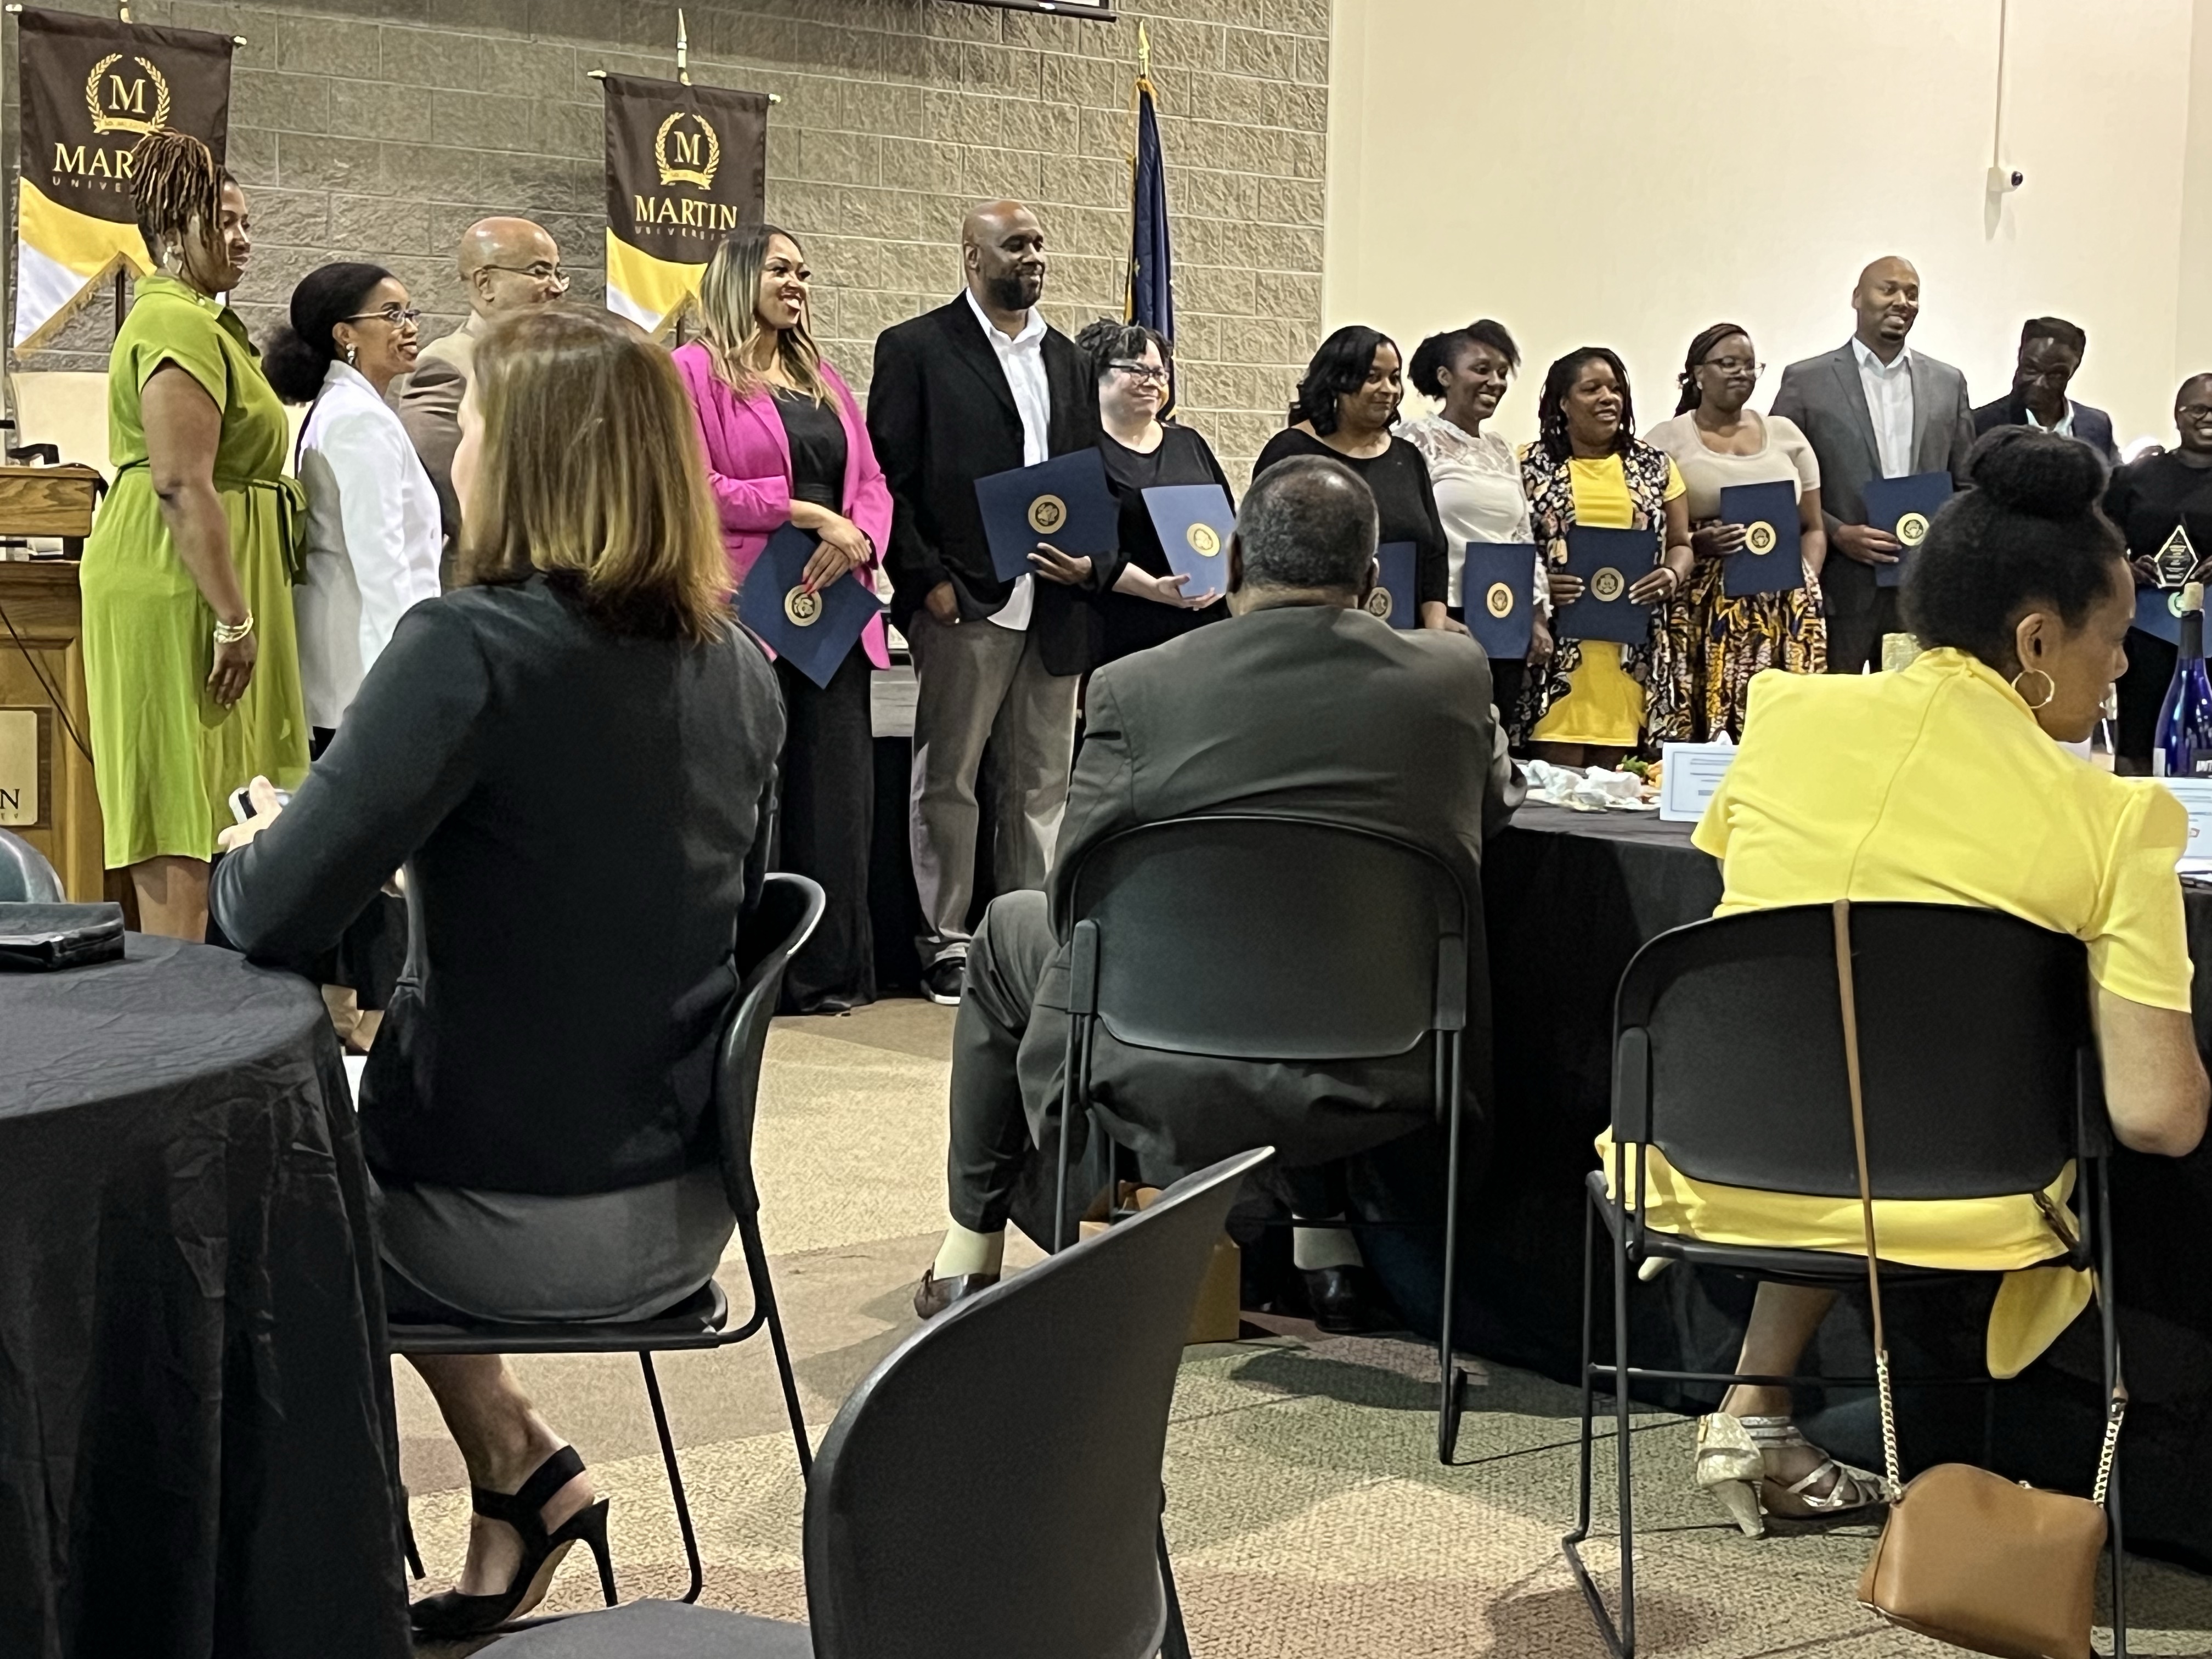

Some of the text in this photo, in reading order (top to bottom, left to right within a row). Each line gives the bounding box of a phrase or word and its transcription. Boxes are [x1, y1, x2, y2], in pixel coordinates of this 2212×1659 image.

[109, 75, 146, 114] M
[674, 131, 701, 165] M
[634, 195, 737, 230] MARTIN
